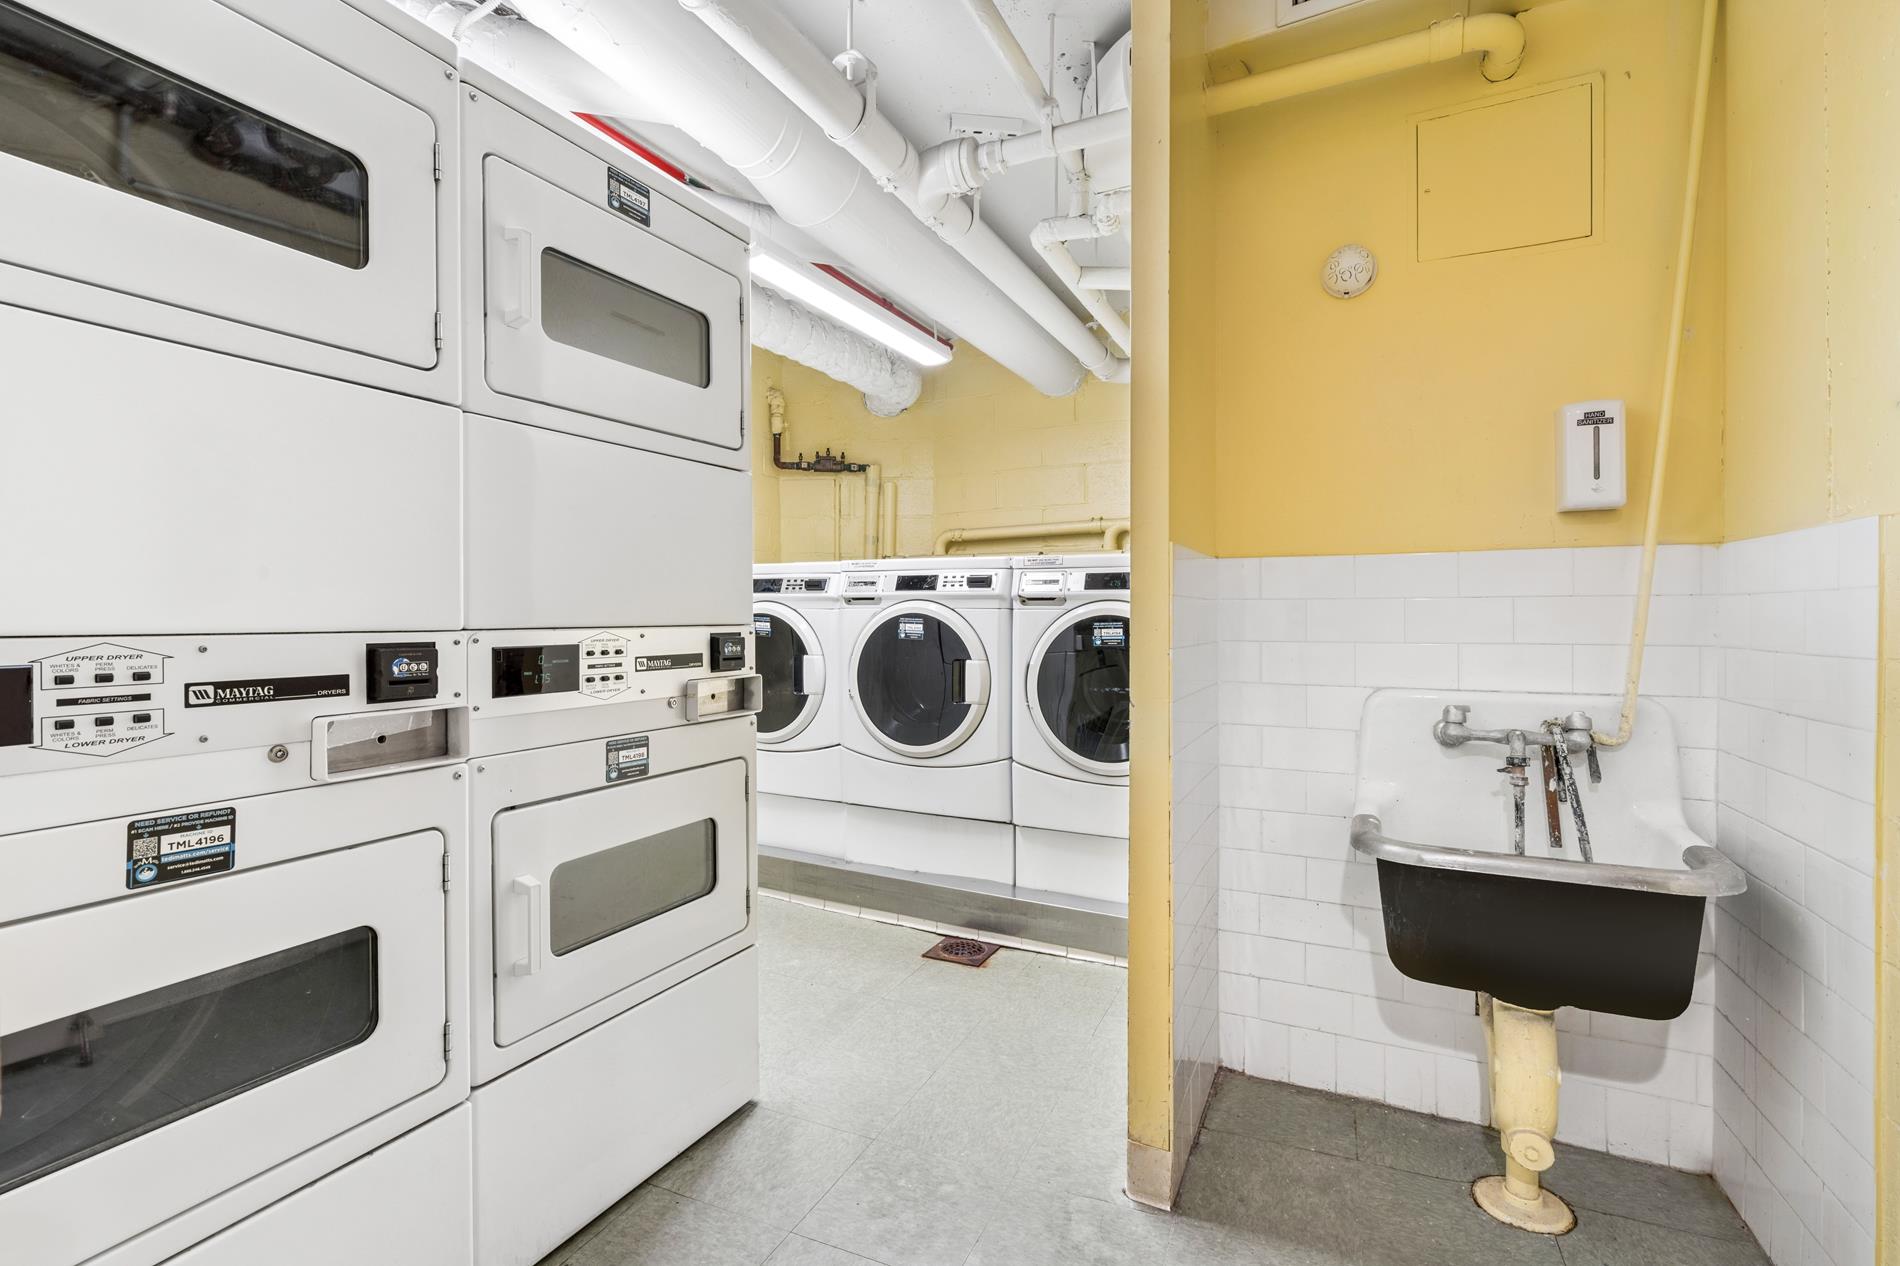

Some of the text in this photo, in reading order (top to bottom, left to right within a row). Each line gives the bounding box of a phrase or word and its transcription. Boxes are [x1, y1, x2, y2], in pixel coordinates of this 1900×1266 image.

[1577, 418, 1613, 426] SANITIZER
[65, 653, 144, 662] UPPER DRYER
[216, 686, 274, 699] MAYTAG
[318, 688, 346, 696] DRYERS
[64, 736, 146, 749] LOWER DRYER
[135, 820, 155, 828] NEED
[157, 814, 187, 824] SERVICE
[200, 809, 231, 818] REFUND?
[181, 819, 204, 827] PROVIDE
[205, 816, 228, 824] MACHINE
[168, 834, 224, 851] TML4196
